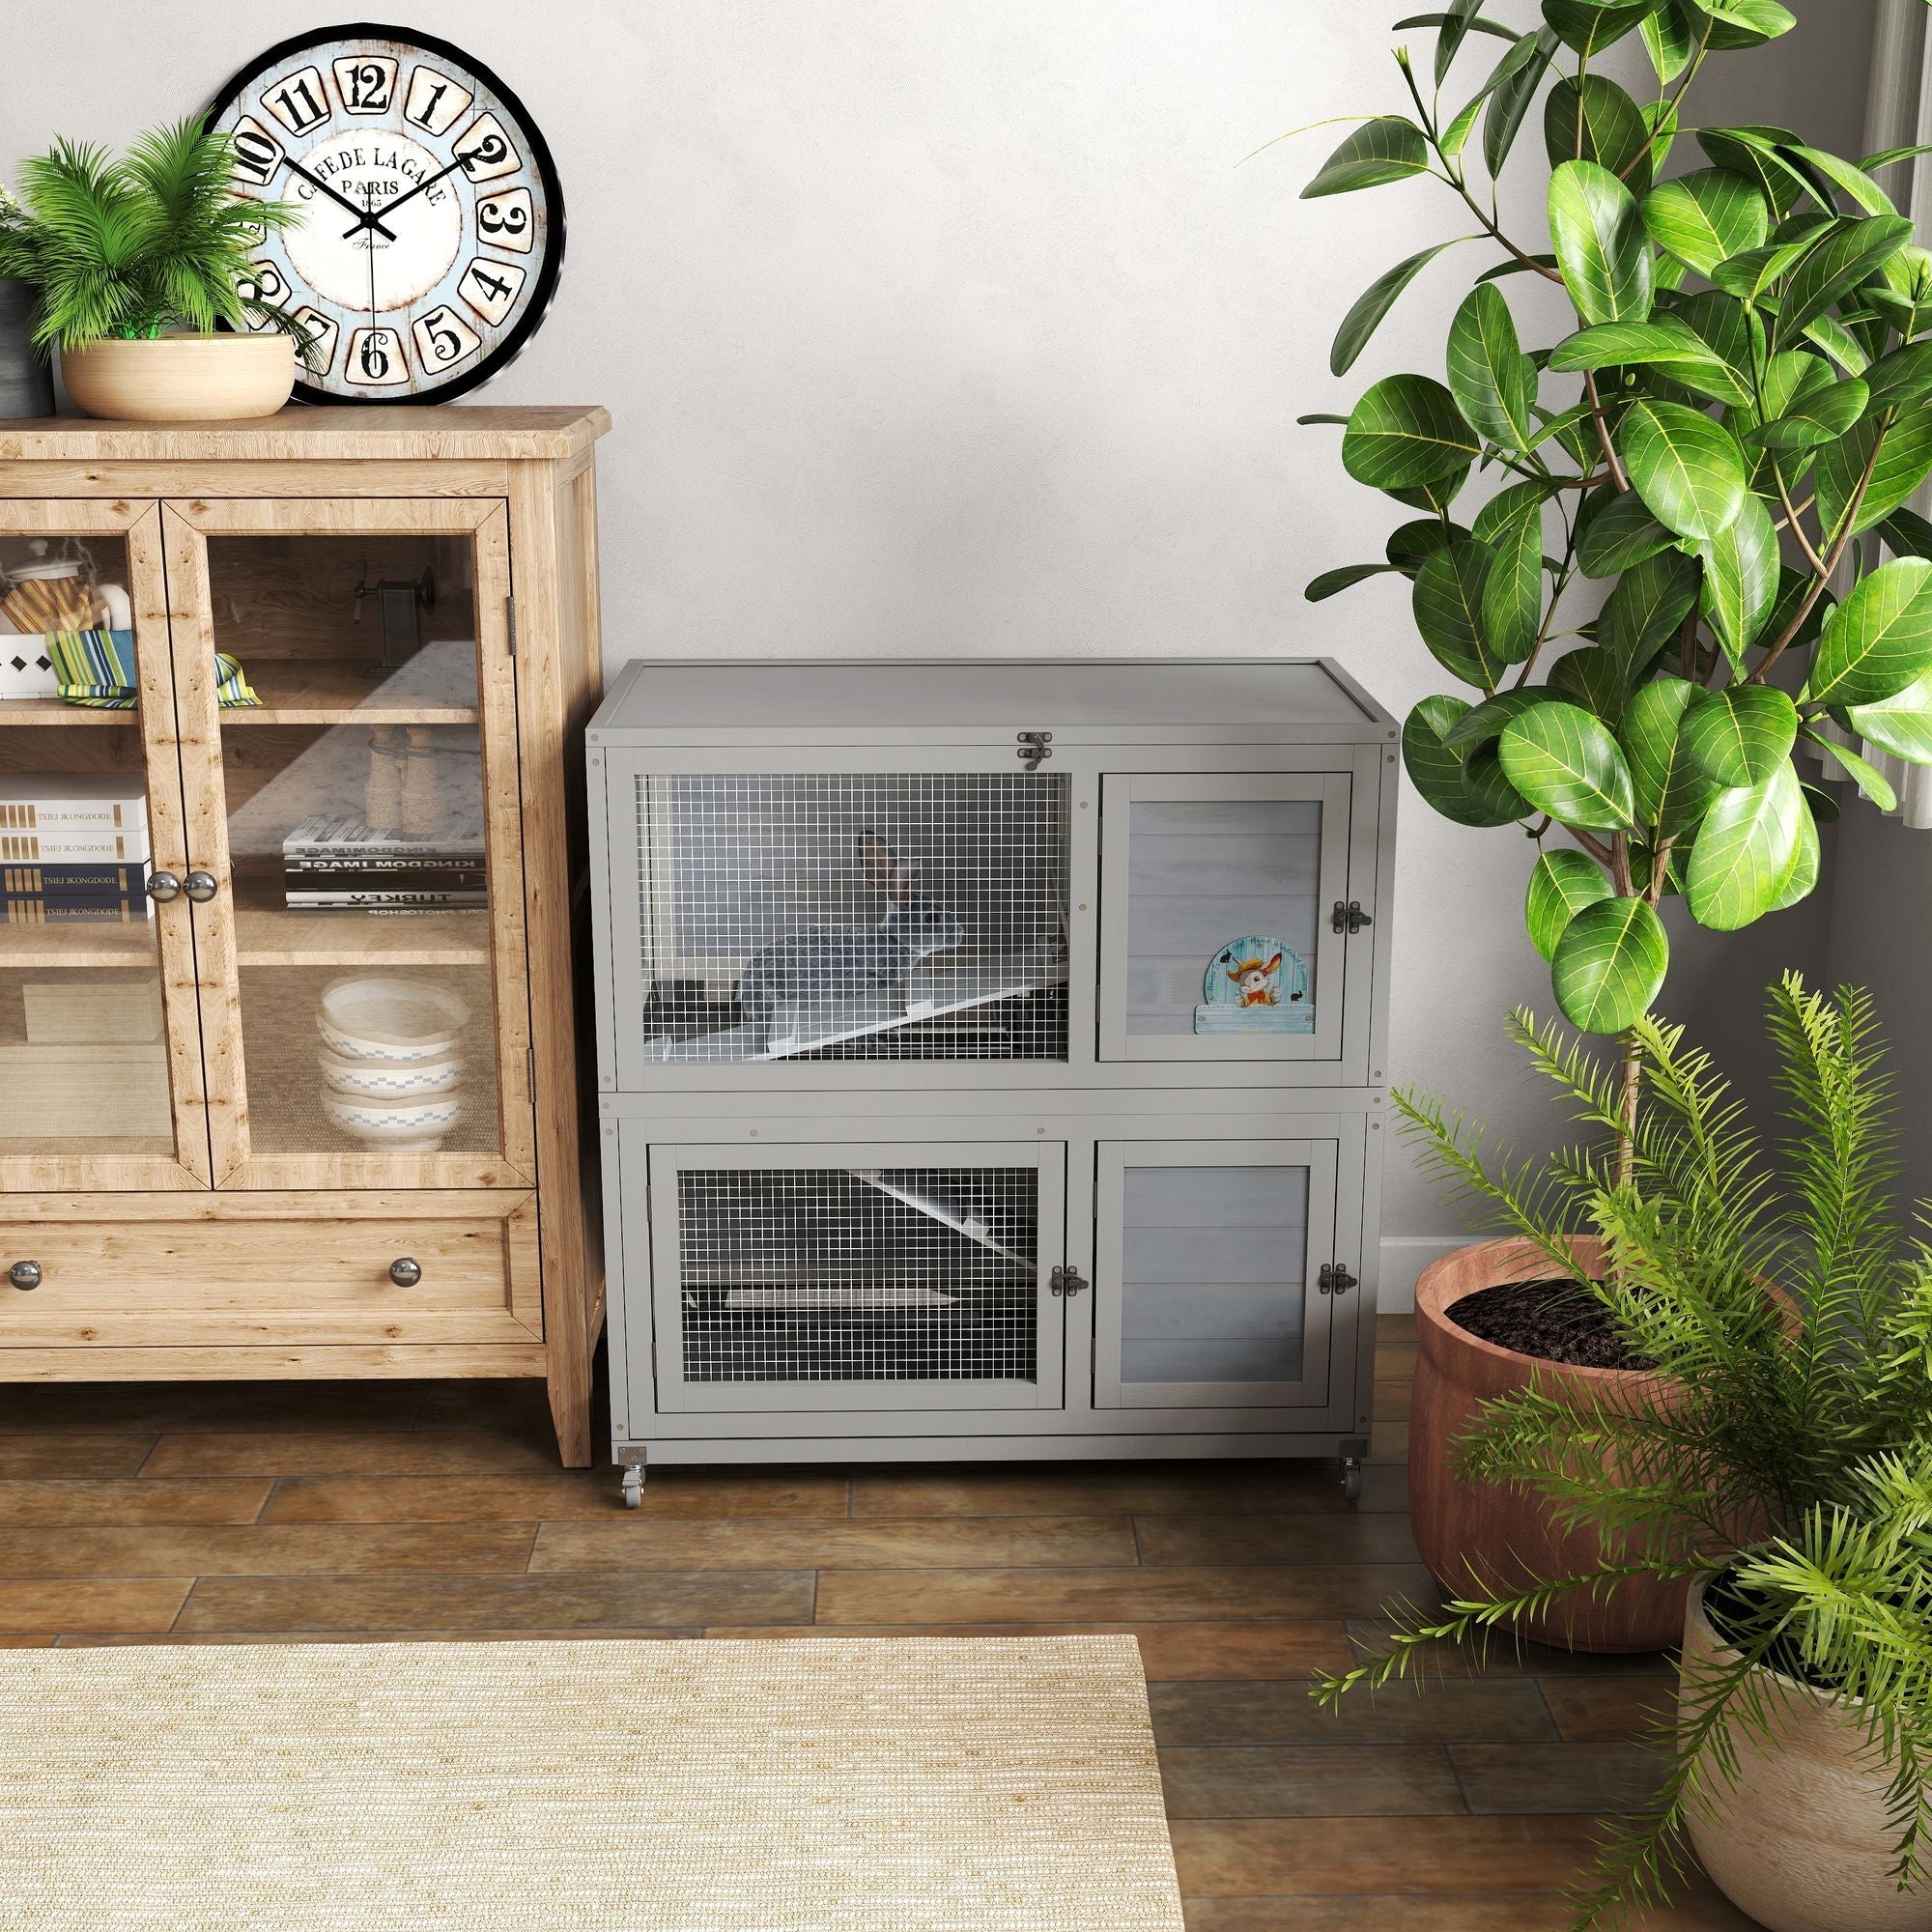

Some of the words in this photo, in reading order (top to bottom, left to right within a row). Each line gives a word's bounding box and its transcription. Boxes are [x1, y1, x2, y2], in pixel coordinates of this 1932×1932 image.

[275, 78, 325, 133] 11
[345, 64, 387, 109] 12
[413, 83, 448, 129] 1
[233, 131, 276, 180] 10
[338, 148, 366, 170] DE
[374, 147, 398, 170] LA
[457, 133, 507, 172] 2
[341, 180, 399, 195] PARIS
[479, 203, 526, 234] 3
[352, 238, 390, 251] France
[470, 267, 513, 301] 4
[360, 331, 388, 380] 6
[424, 312, 462, 361] 5
